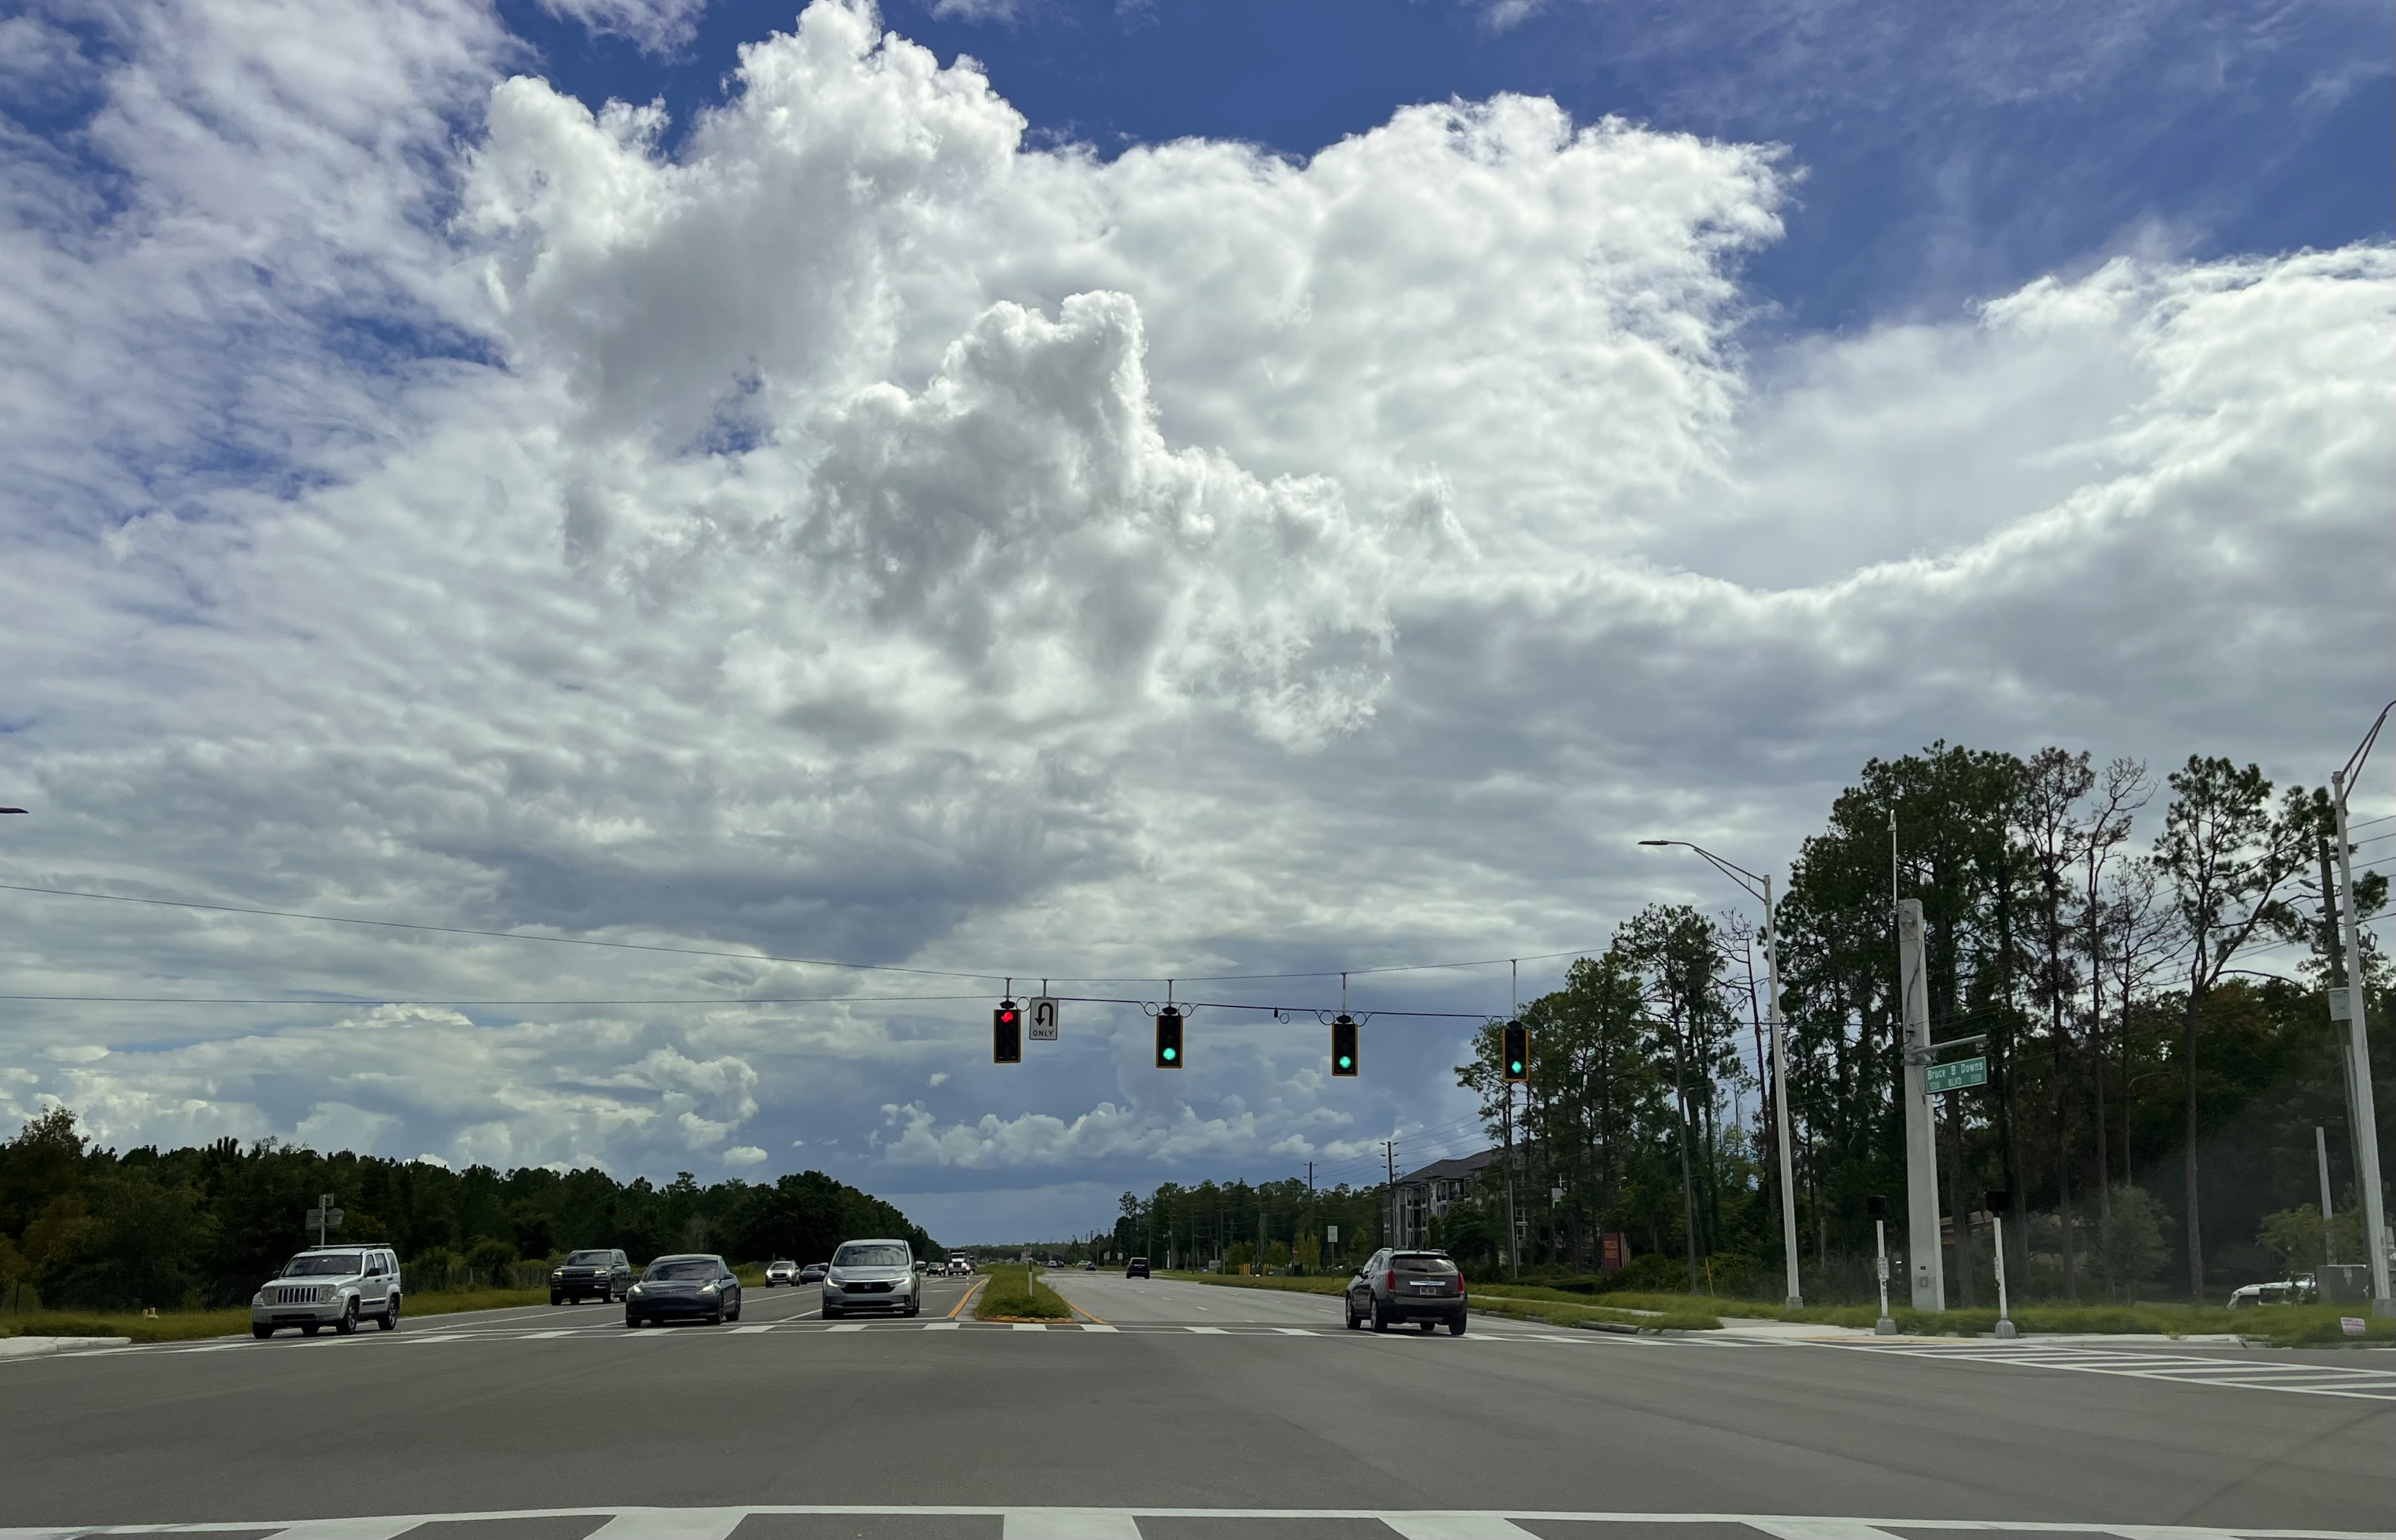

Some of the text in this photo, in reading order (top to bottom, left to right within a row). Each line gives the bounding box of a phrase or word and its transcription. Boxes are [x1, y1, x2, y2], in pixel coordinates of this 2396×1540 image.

[1928, 1062, 1983, 1080] Bruce B Downs
[1948, 1077, 1962, 1087] BLVD
